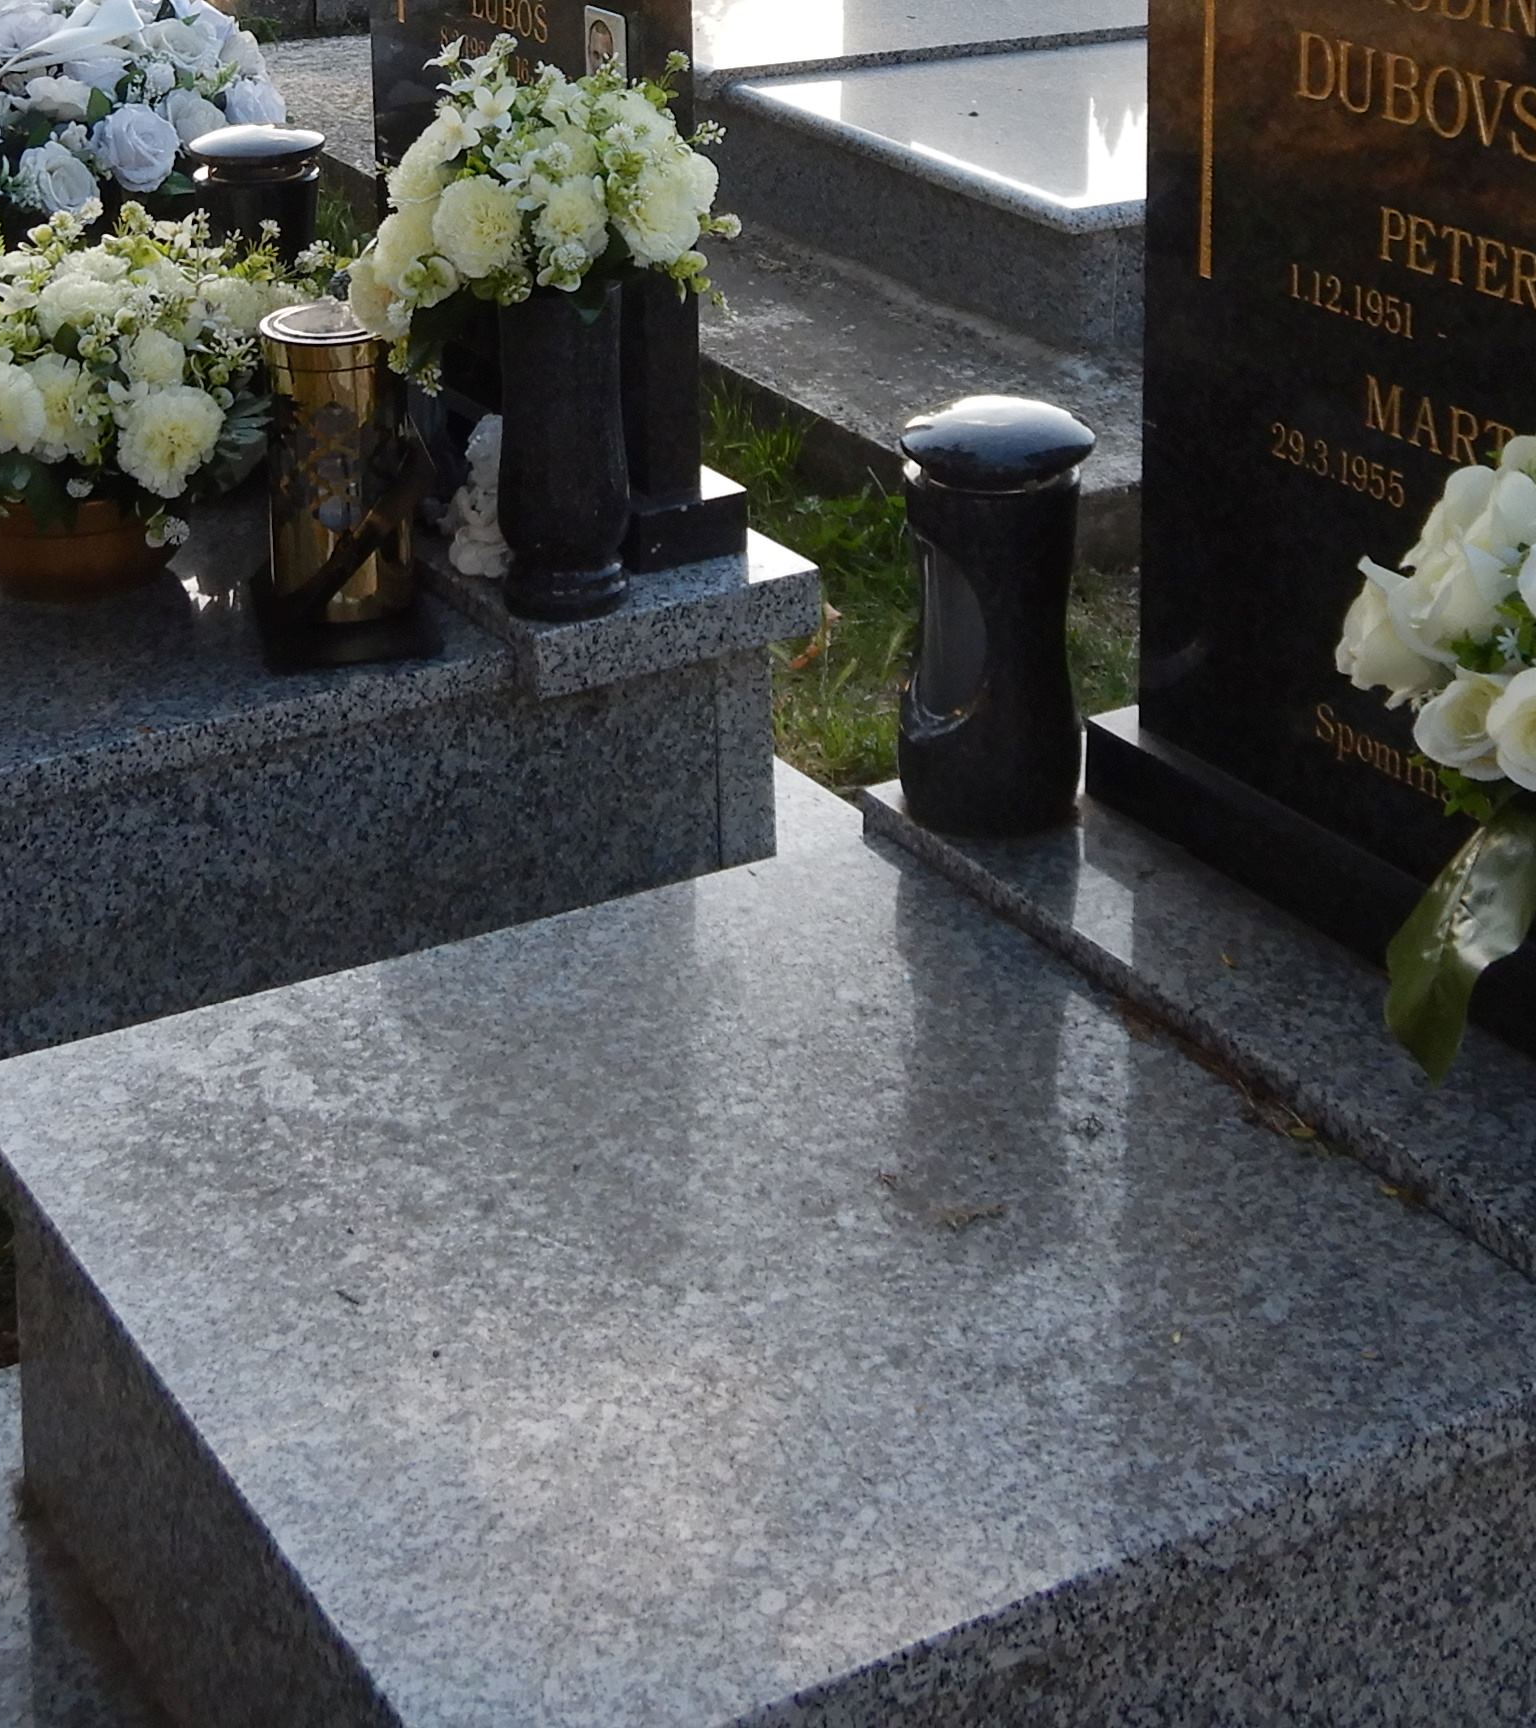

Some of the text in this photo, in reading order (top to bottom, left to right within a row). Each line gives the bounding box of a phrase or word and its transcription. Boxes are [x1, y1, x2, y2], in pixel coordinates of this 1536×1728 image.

[1289, 263, 1413, 340] 1.12.1951
[1365, 373, 1516, 468] MART
[1271, 422, 1405, 508] 29.3.1955
